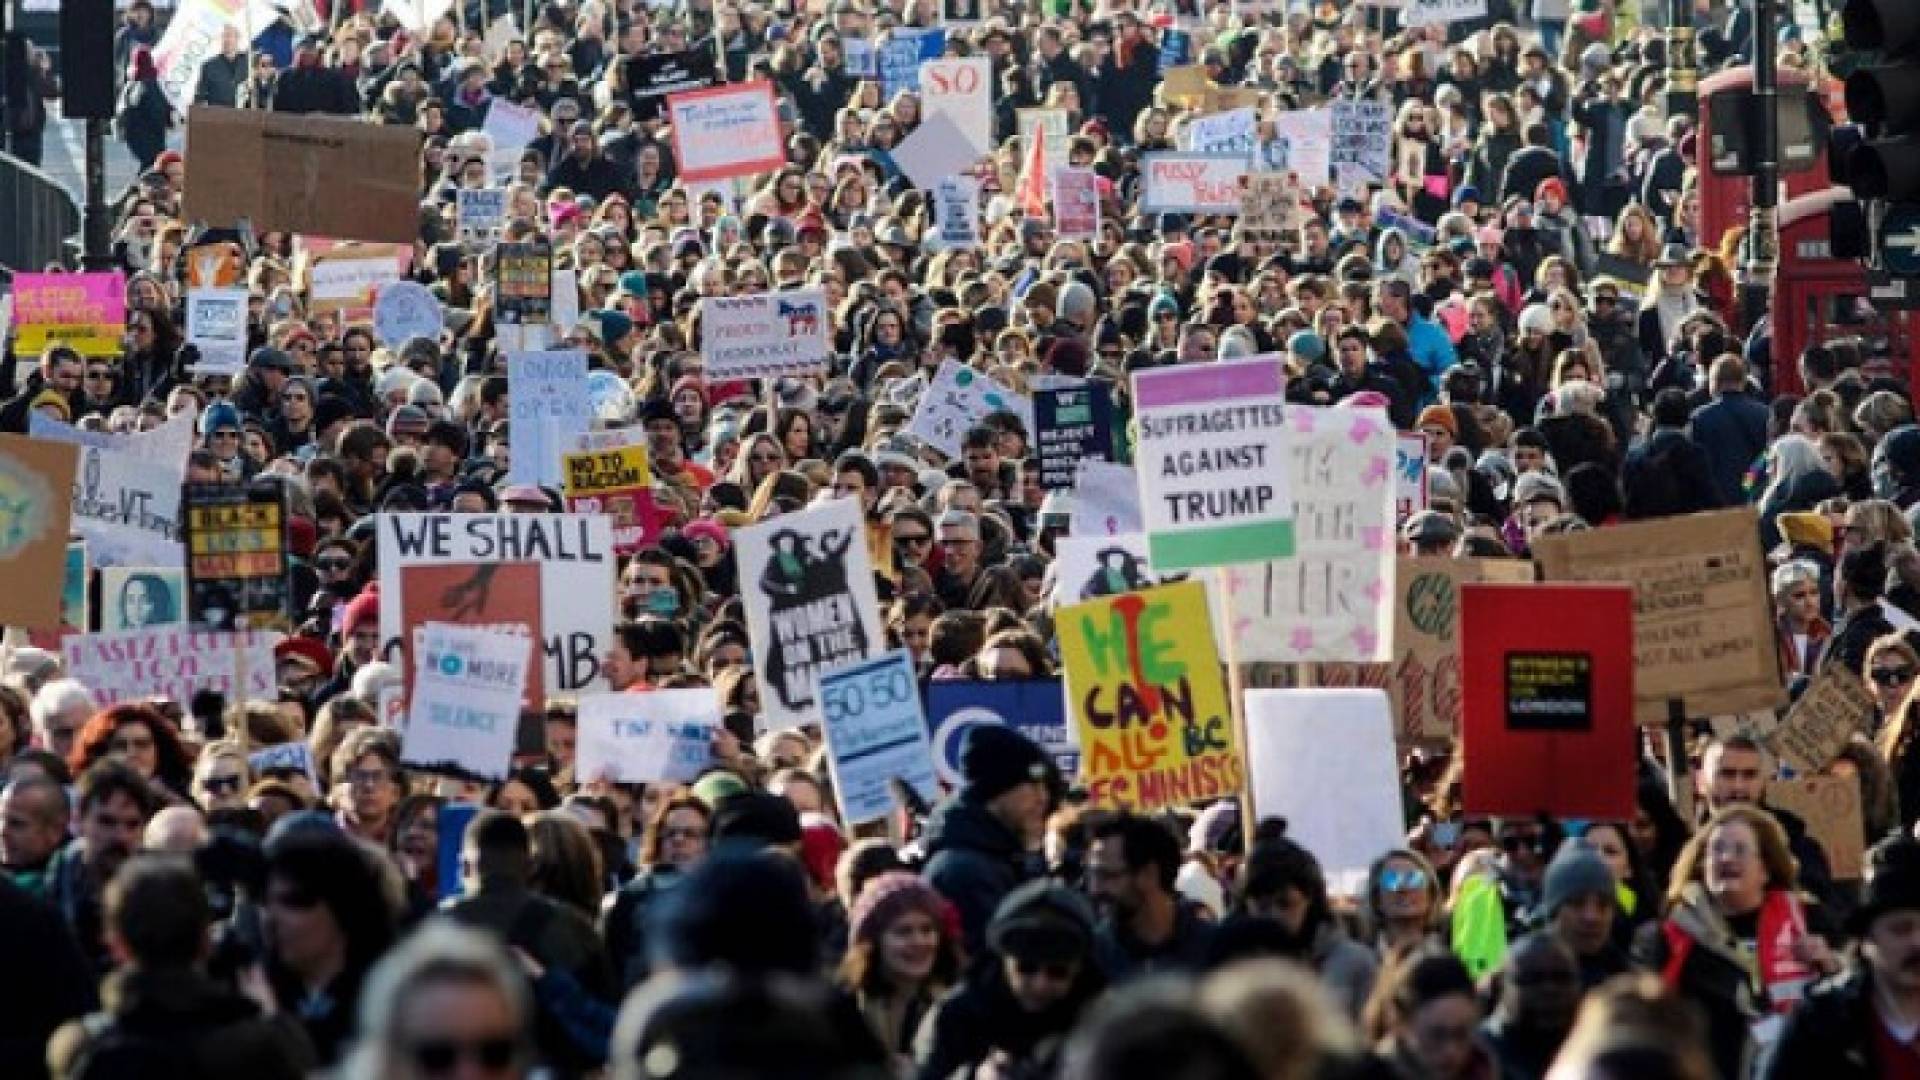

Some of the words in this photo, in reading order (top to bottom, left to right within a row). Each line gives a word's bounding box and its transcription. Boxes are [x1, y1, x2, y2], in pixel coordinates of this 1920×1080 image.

[1141, 404, 1284, 440] SUFFRAGETTES
[568, 456, 594, 472] NO
[599, 452, 621, 472] TO
[1161, 445, 1267, 477] AGAINST
[571, 469, 640, 488] RACISM
[1163, 485, 1273, 524] TRUMP
[393, 515, 452, 556] WE
[466, 518, 603, 562] SHALL
[466, 658, 520, 685] MORE
[1083, 674, 1195, 730] CAN
[1510, 700, 1586, 714] LONDON
